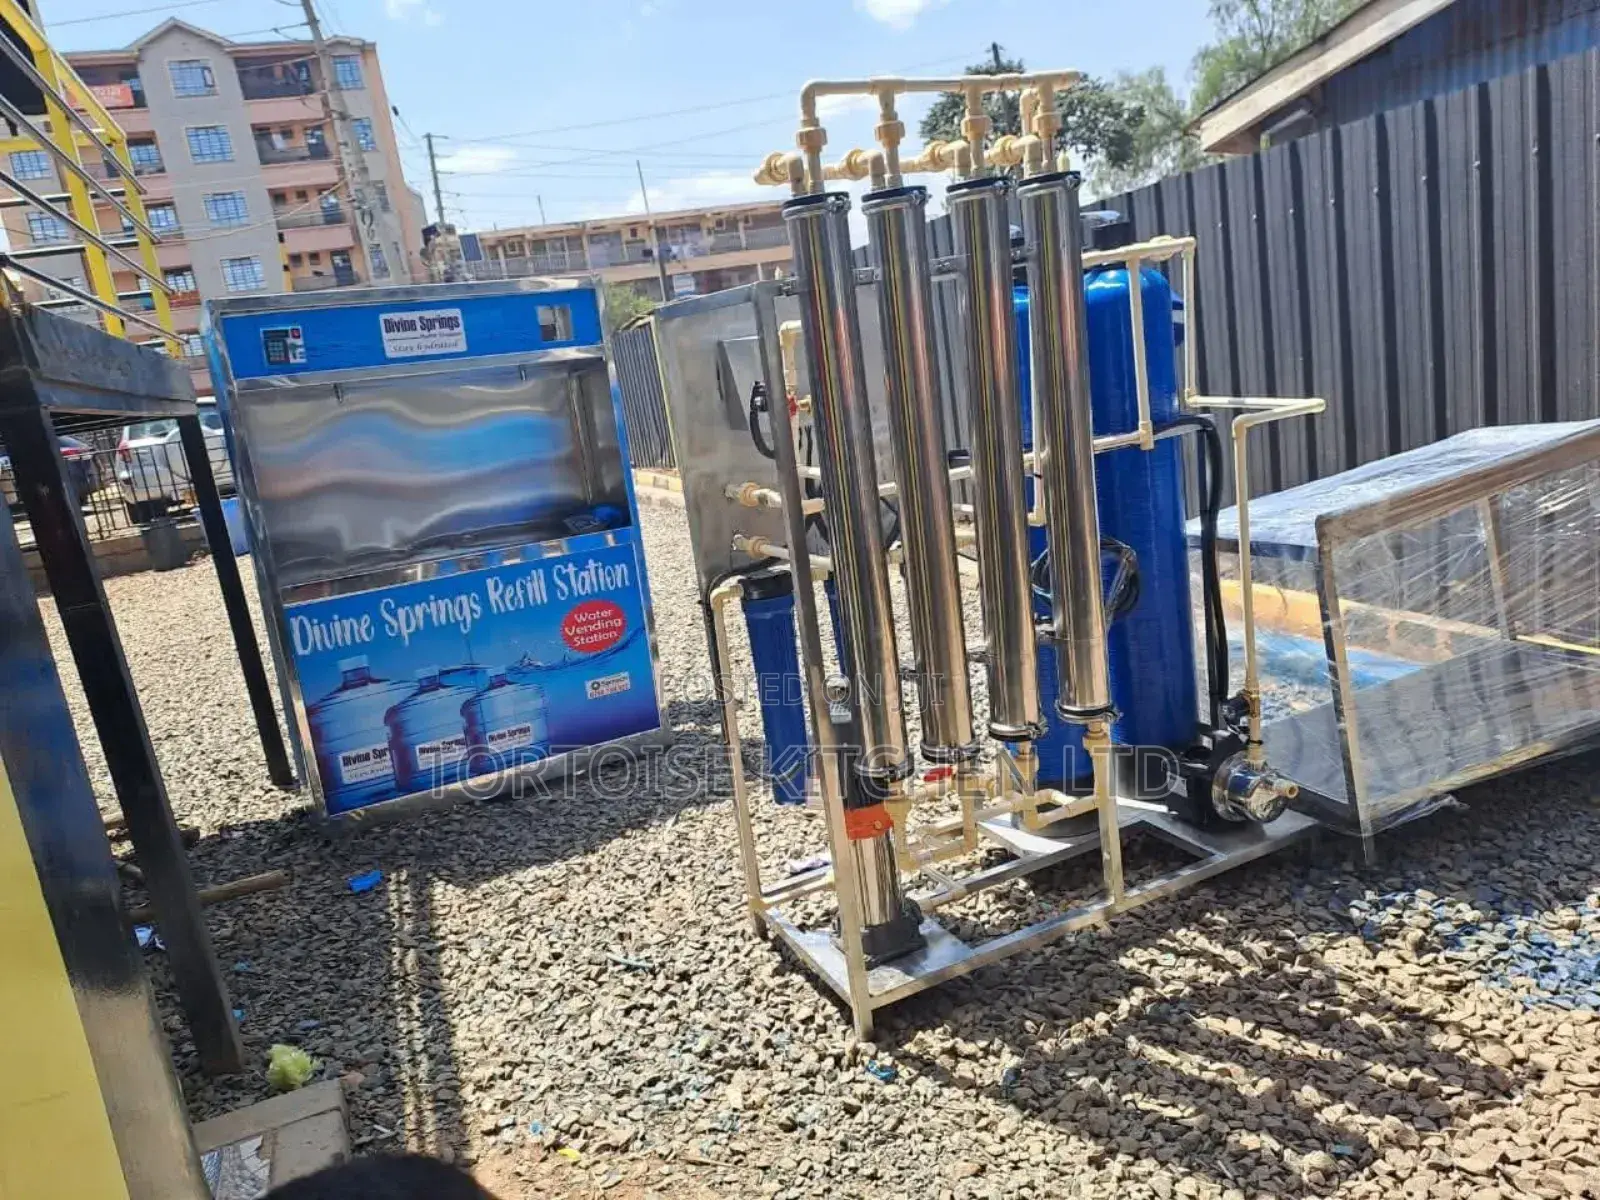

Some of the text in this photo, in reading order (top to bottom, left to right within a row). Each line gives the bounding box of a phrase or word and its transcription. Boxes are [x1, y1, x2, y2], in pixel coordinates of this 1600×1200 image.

[383, 315, 460, 333] Divine Springs
[289, 558, 630, 656] Divine Springs Refill Station
[574, 609, 613, 623] Water
[564, 618, 622, 636] Vending
[573, 630, 618, 647] Station
[342, 752, 371, 767] Divine
